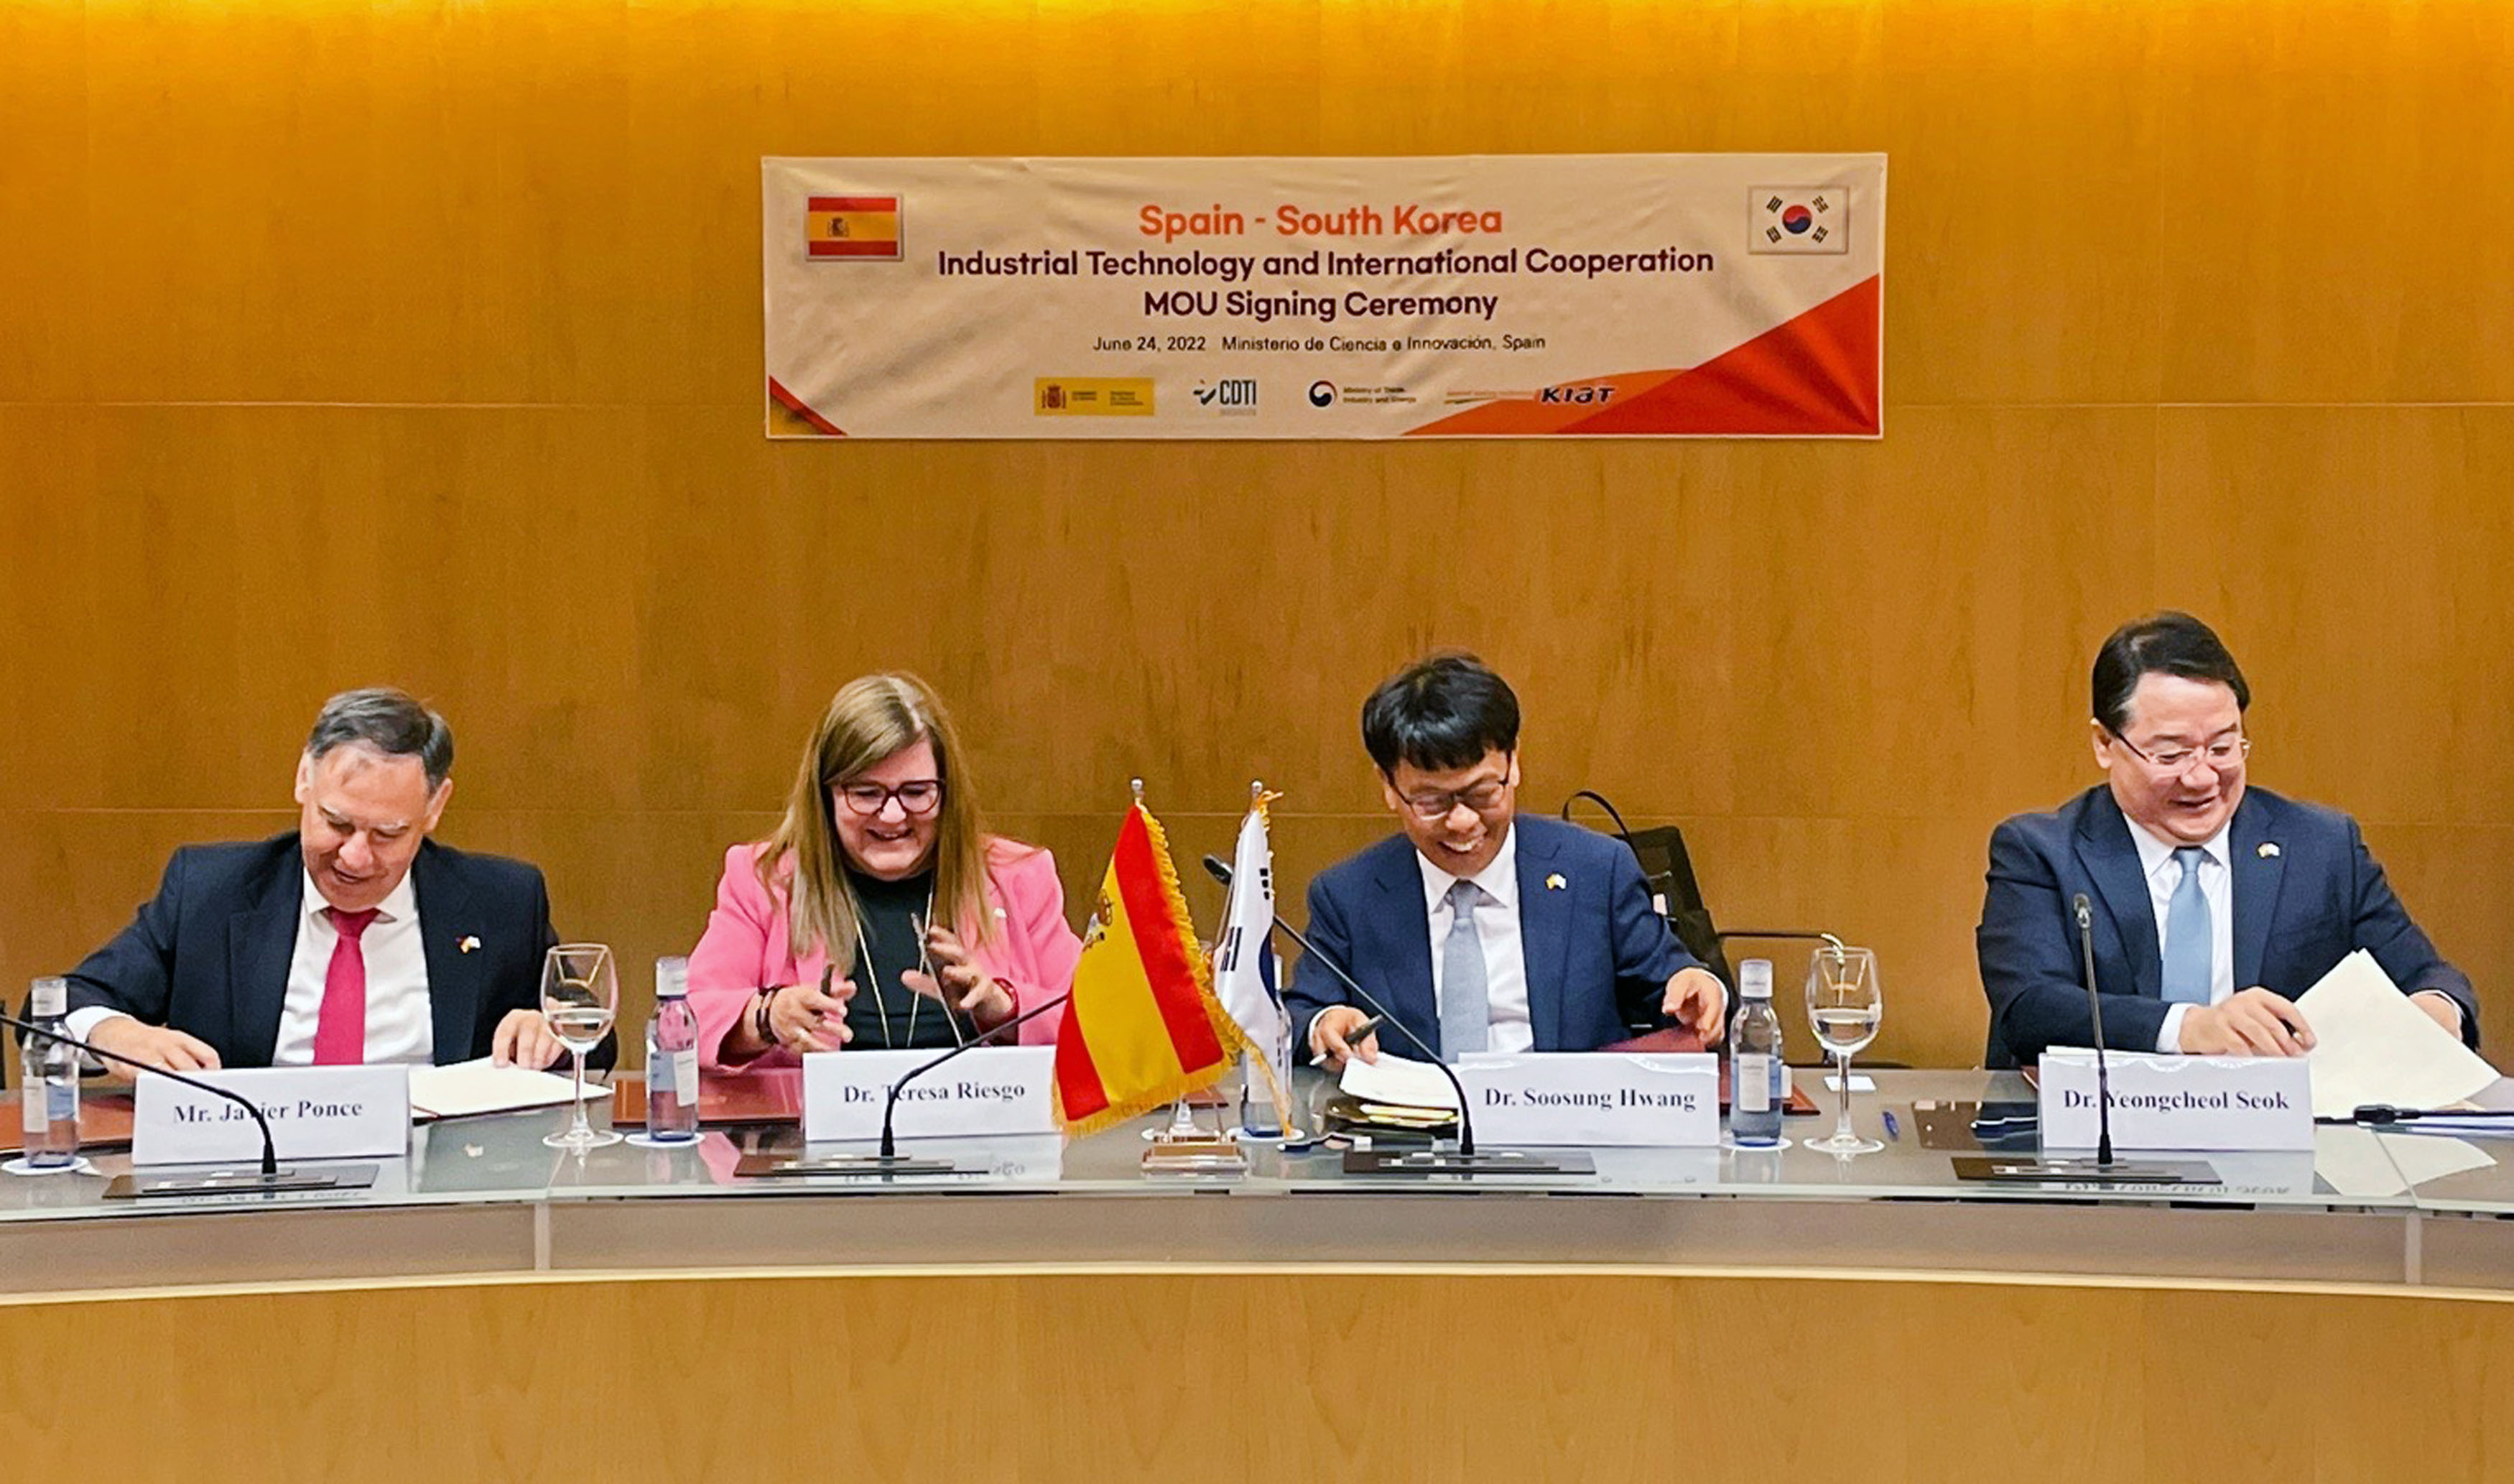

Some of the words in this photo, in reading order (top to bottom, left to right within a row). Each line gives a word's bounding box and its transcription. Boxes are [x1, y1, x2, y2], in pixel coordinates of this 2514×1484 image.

[1139, 204, 1244, 244] Spain
[1276, 204, 1382, 236] South
[1394, 205, 1502, 236] Korea
[940, 249, 1077, 275] Industrial
[1085, 250, 1255, 282] Technology
[1263, 250, 1319, 276] and
[1328, 248, 1517, 276] International
[1526, 246, 1714, 279] Cooperation
[1144, 291, 1217, 316] MOU
[1225, 290, 1336, 323] Signing
[1345, 291, 1499, 321] Ceremony
[1093, 336, 1132, 351] June
[1137, 336, 1161, 353] 24,
[1166, 336, 1206, 351] 2022
[1222, 336, 1300, 351] Ministerio
[1304, 336, 1325, 351] de
[1330, 335, 1387, 352] Ciencia
[1502, 334, 1546, 352] Spain
[1220, 379, 1256, 405] CDTI
[844, 1085, 875, 1103] Dr.
[957, 1082, 1025, 1102] Riesgo
[1485, 1088, 1516, 1106] Dr.
[1523, 1089, 1613, 1110] Soosung
[1620, 1089, 1696, 1112] Hwang
[2065, 1090, 2096, 1107] Dr.
[2236, 1090, 2289, 1109] Seok
[174, 1105, 212, 1123] Mr.
[219, 1101, 289, 1121] Jaier
[297, 1100, 363, 1118] Ponce
